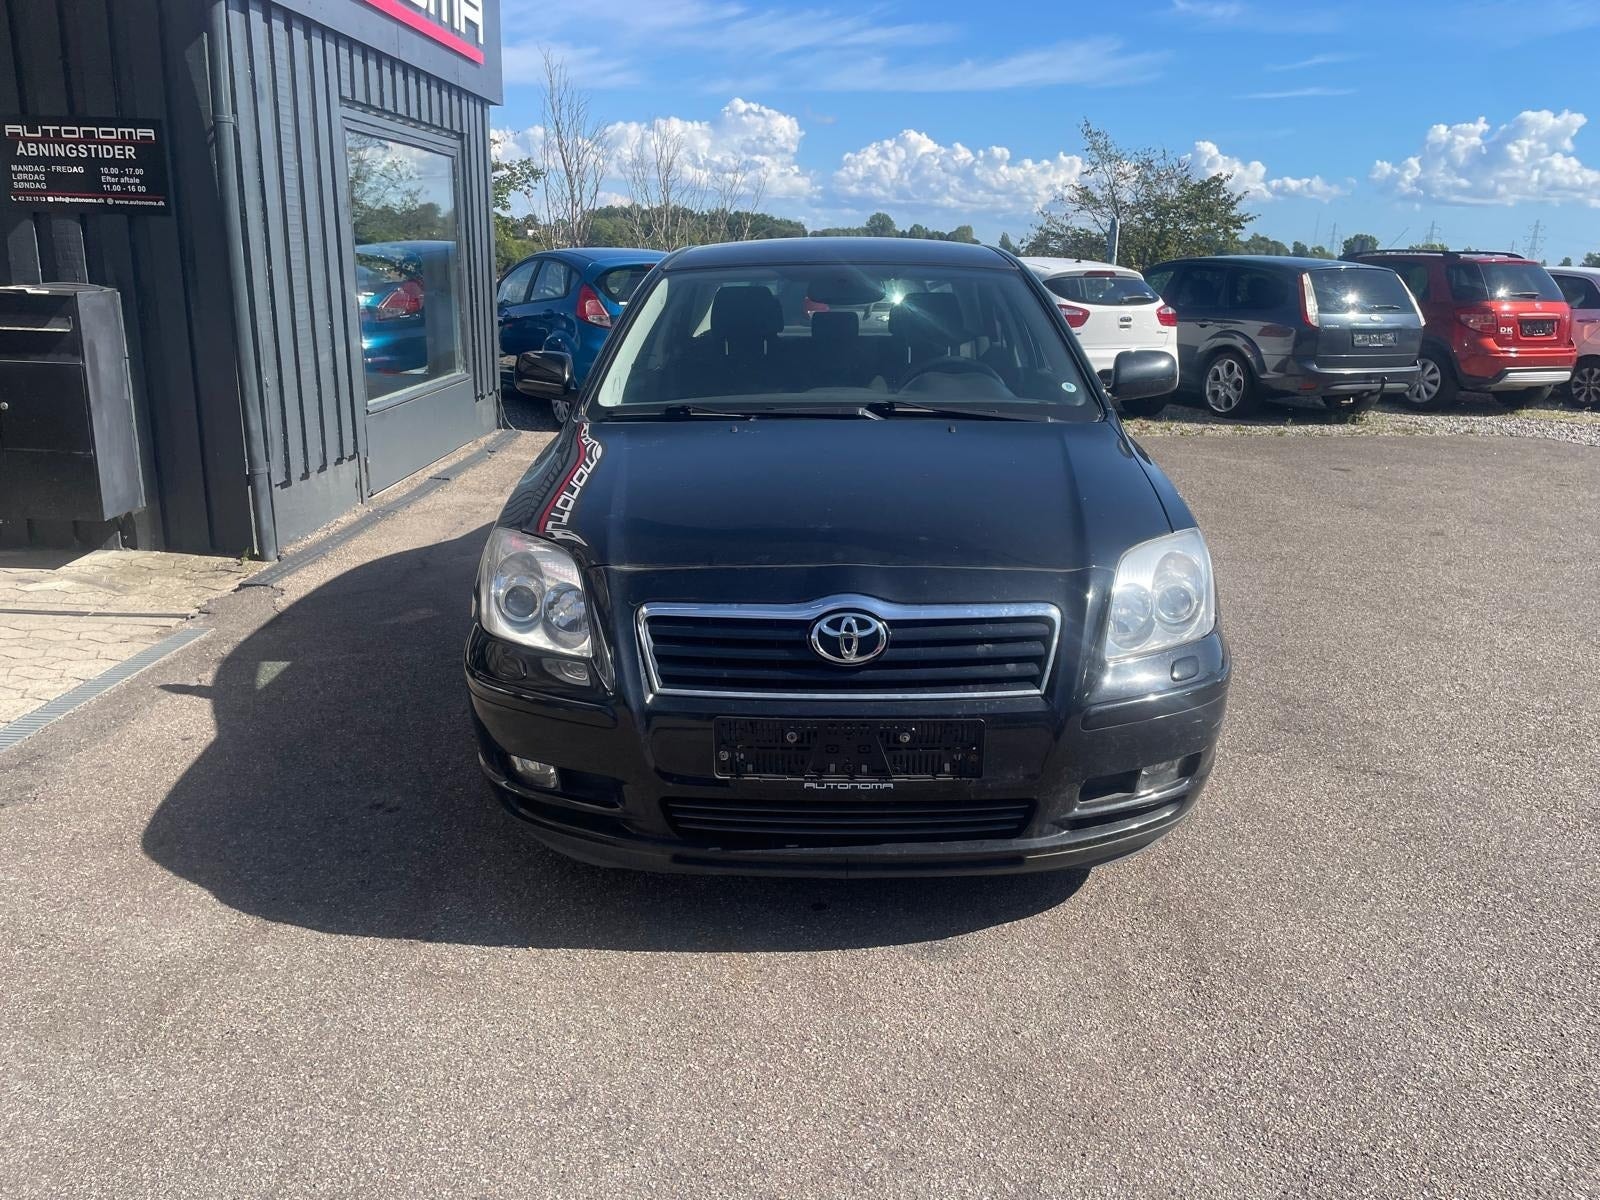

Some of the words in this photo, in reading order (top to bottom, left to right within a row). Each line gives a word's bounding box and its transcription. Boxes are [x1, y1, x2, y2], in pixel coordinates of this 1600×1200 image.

[5, 125, 155, 140] AUTONOMA
[16, 141, 136, 159] ÅBNINGSTIDER
[11, 165, 46, 173] MANDAG
[51, 166, 85, 174] FREDAG
[100, 167, 119, 175] 10.00
[125, 168, 144, 176] 17.00
[12, 173, 46, 181] LØRDAG
[101, 175, 119, 183] Efter
[120, 176, 140, 184] aftale
[13, 181, 47, 190] SØNDAG
[103, 184, 121, 192] 11.00
[804, 782, 894, 790] AUTONOMA
